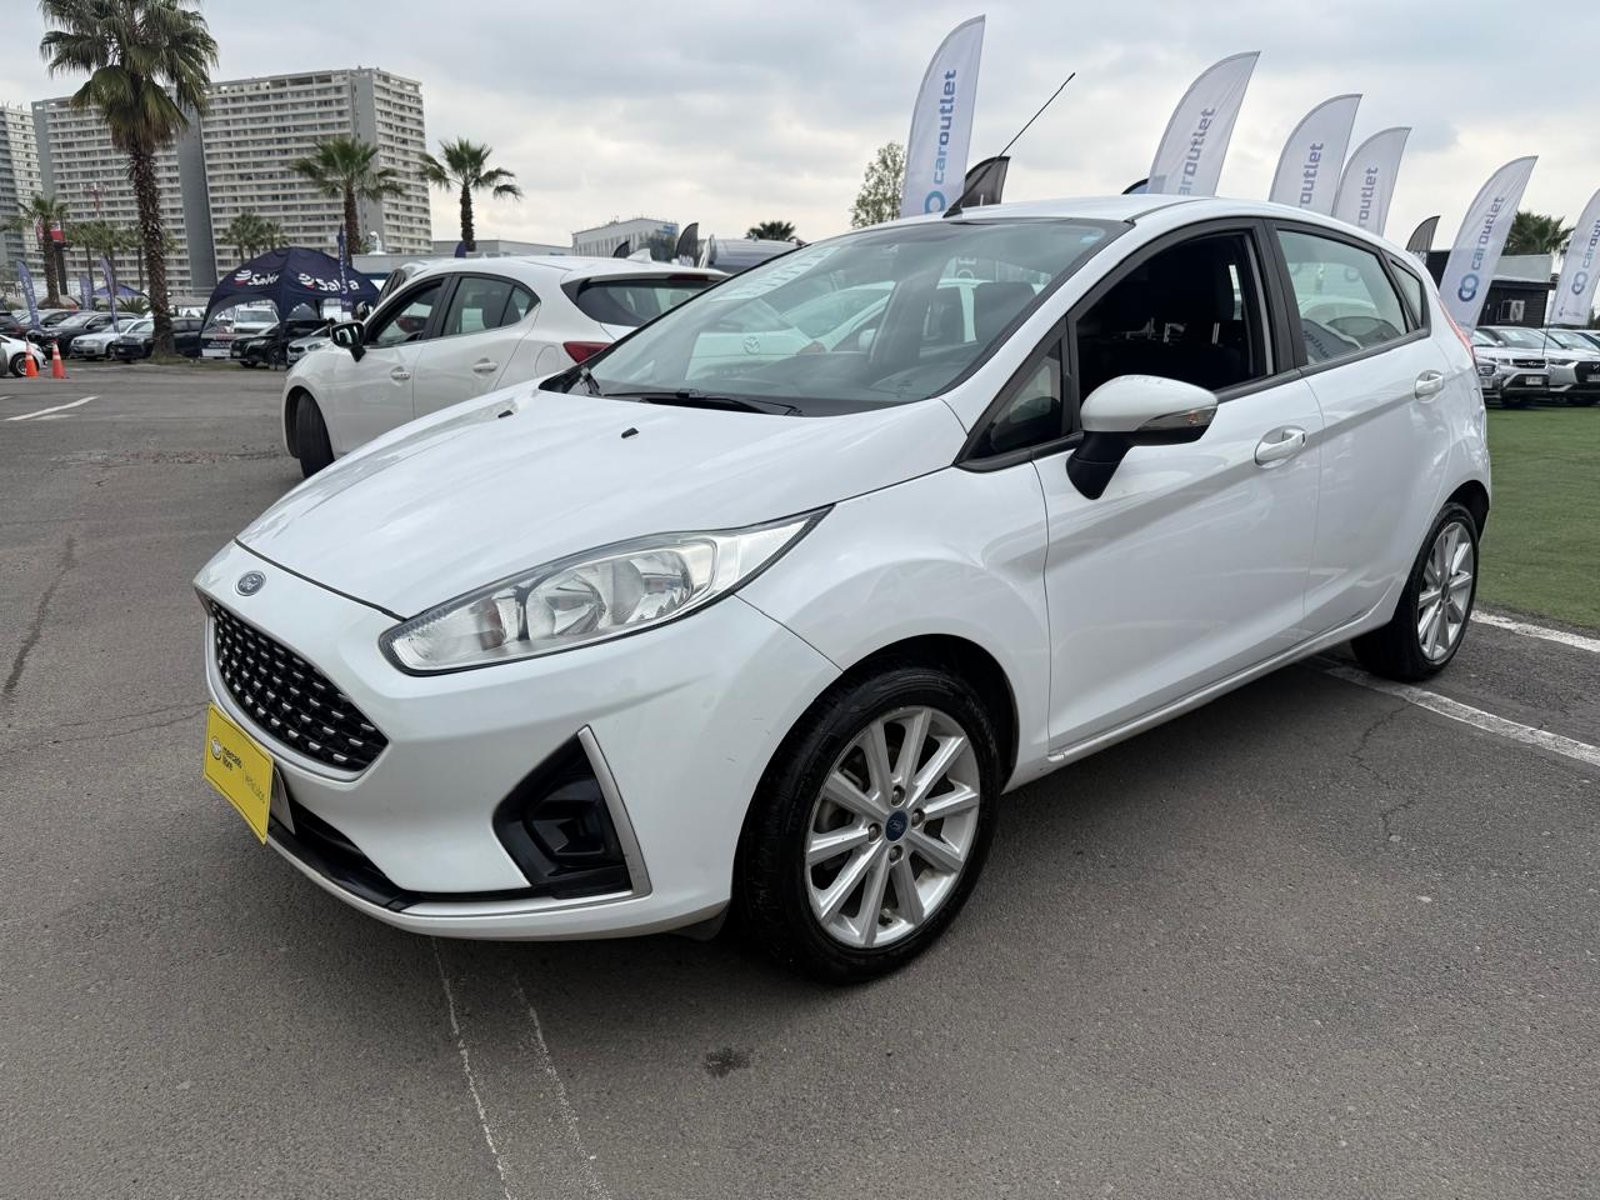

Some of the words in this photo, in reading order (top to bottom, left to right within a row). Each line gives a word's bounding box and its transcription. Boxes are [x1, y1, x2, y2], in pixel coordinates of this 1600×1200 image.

[933, 69, 957, 185] caroutlet
[1299, 143, 1324, 208] outlet
[1472, 196, 1505, 270] caroutlet
[318, 278, 360, 292] Sala
